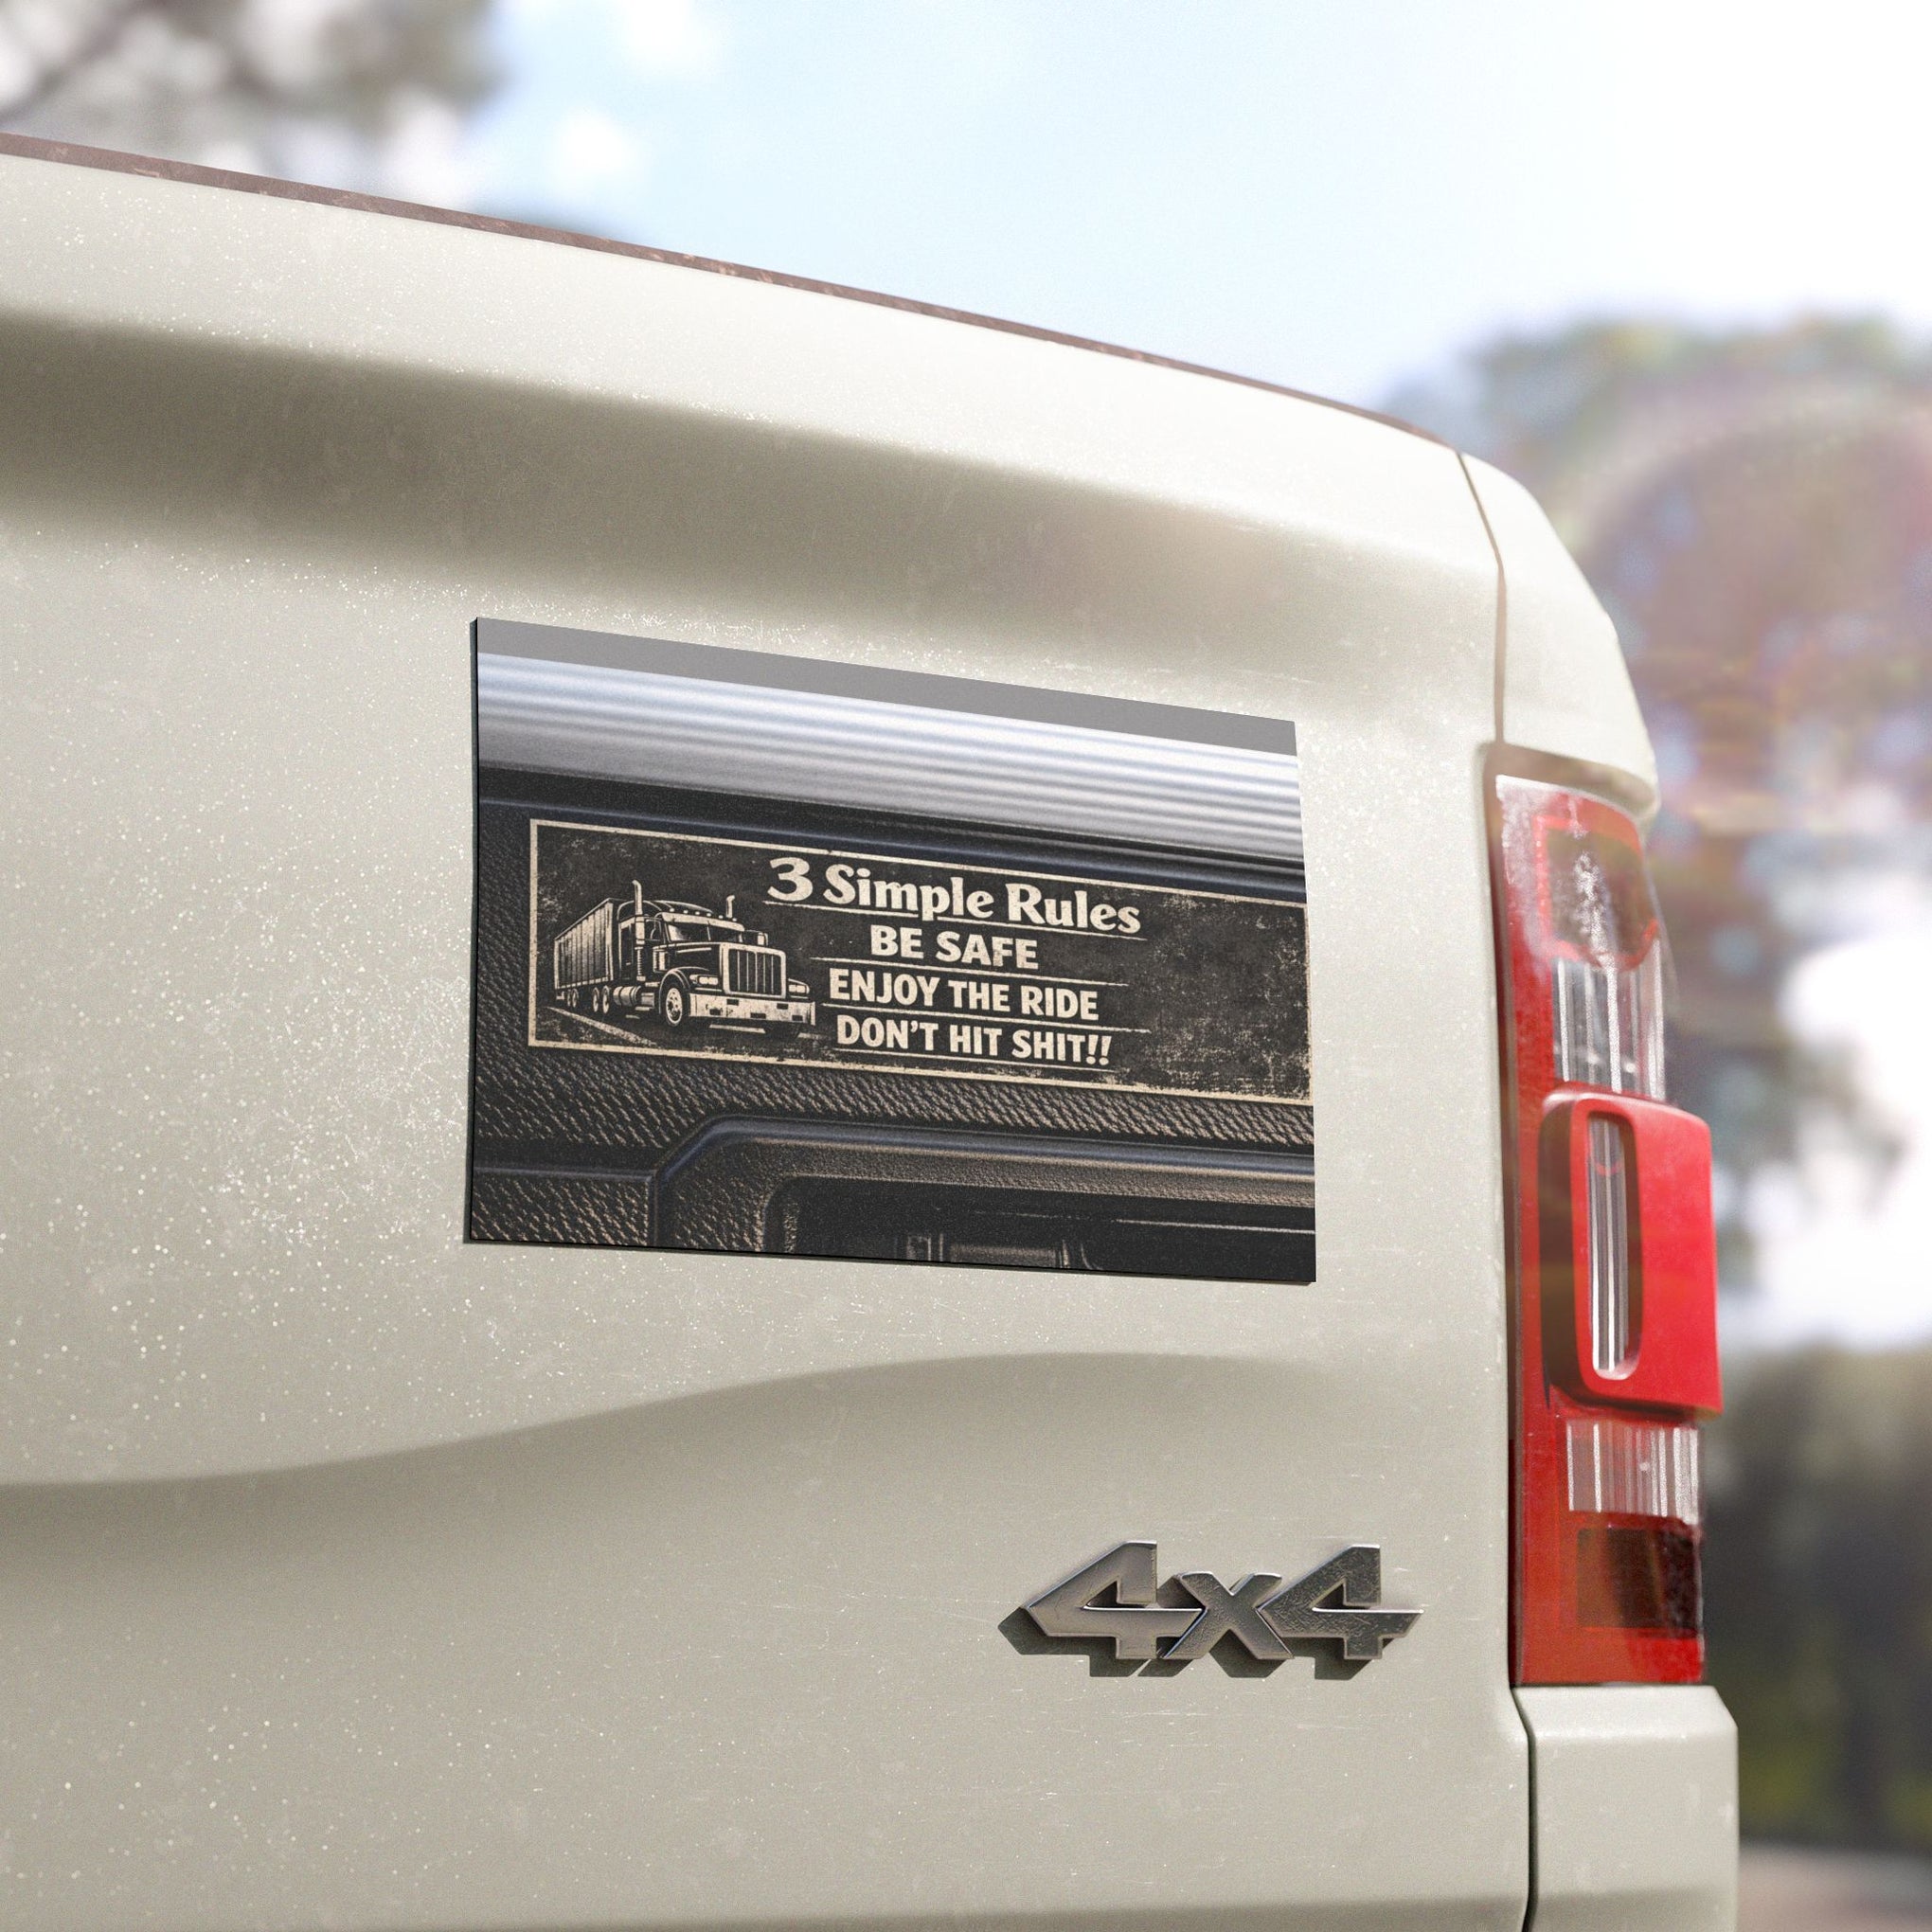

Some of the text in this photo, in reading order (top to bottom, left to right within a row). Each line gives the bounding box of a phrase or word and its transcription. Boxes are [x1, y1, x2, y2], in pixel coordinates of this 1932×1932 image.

[767, 857, 1141, 933] 3 Simple Rules
[870, 924, 1038, 969] BE SAFE
[829, 968, 1099, 1021] ENJOY THE RIDE
[836, 1014, 1112, 1065] DON'T HIT SHIT!!
